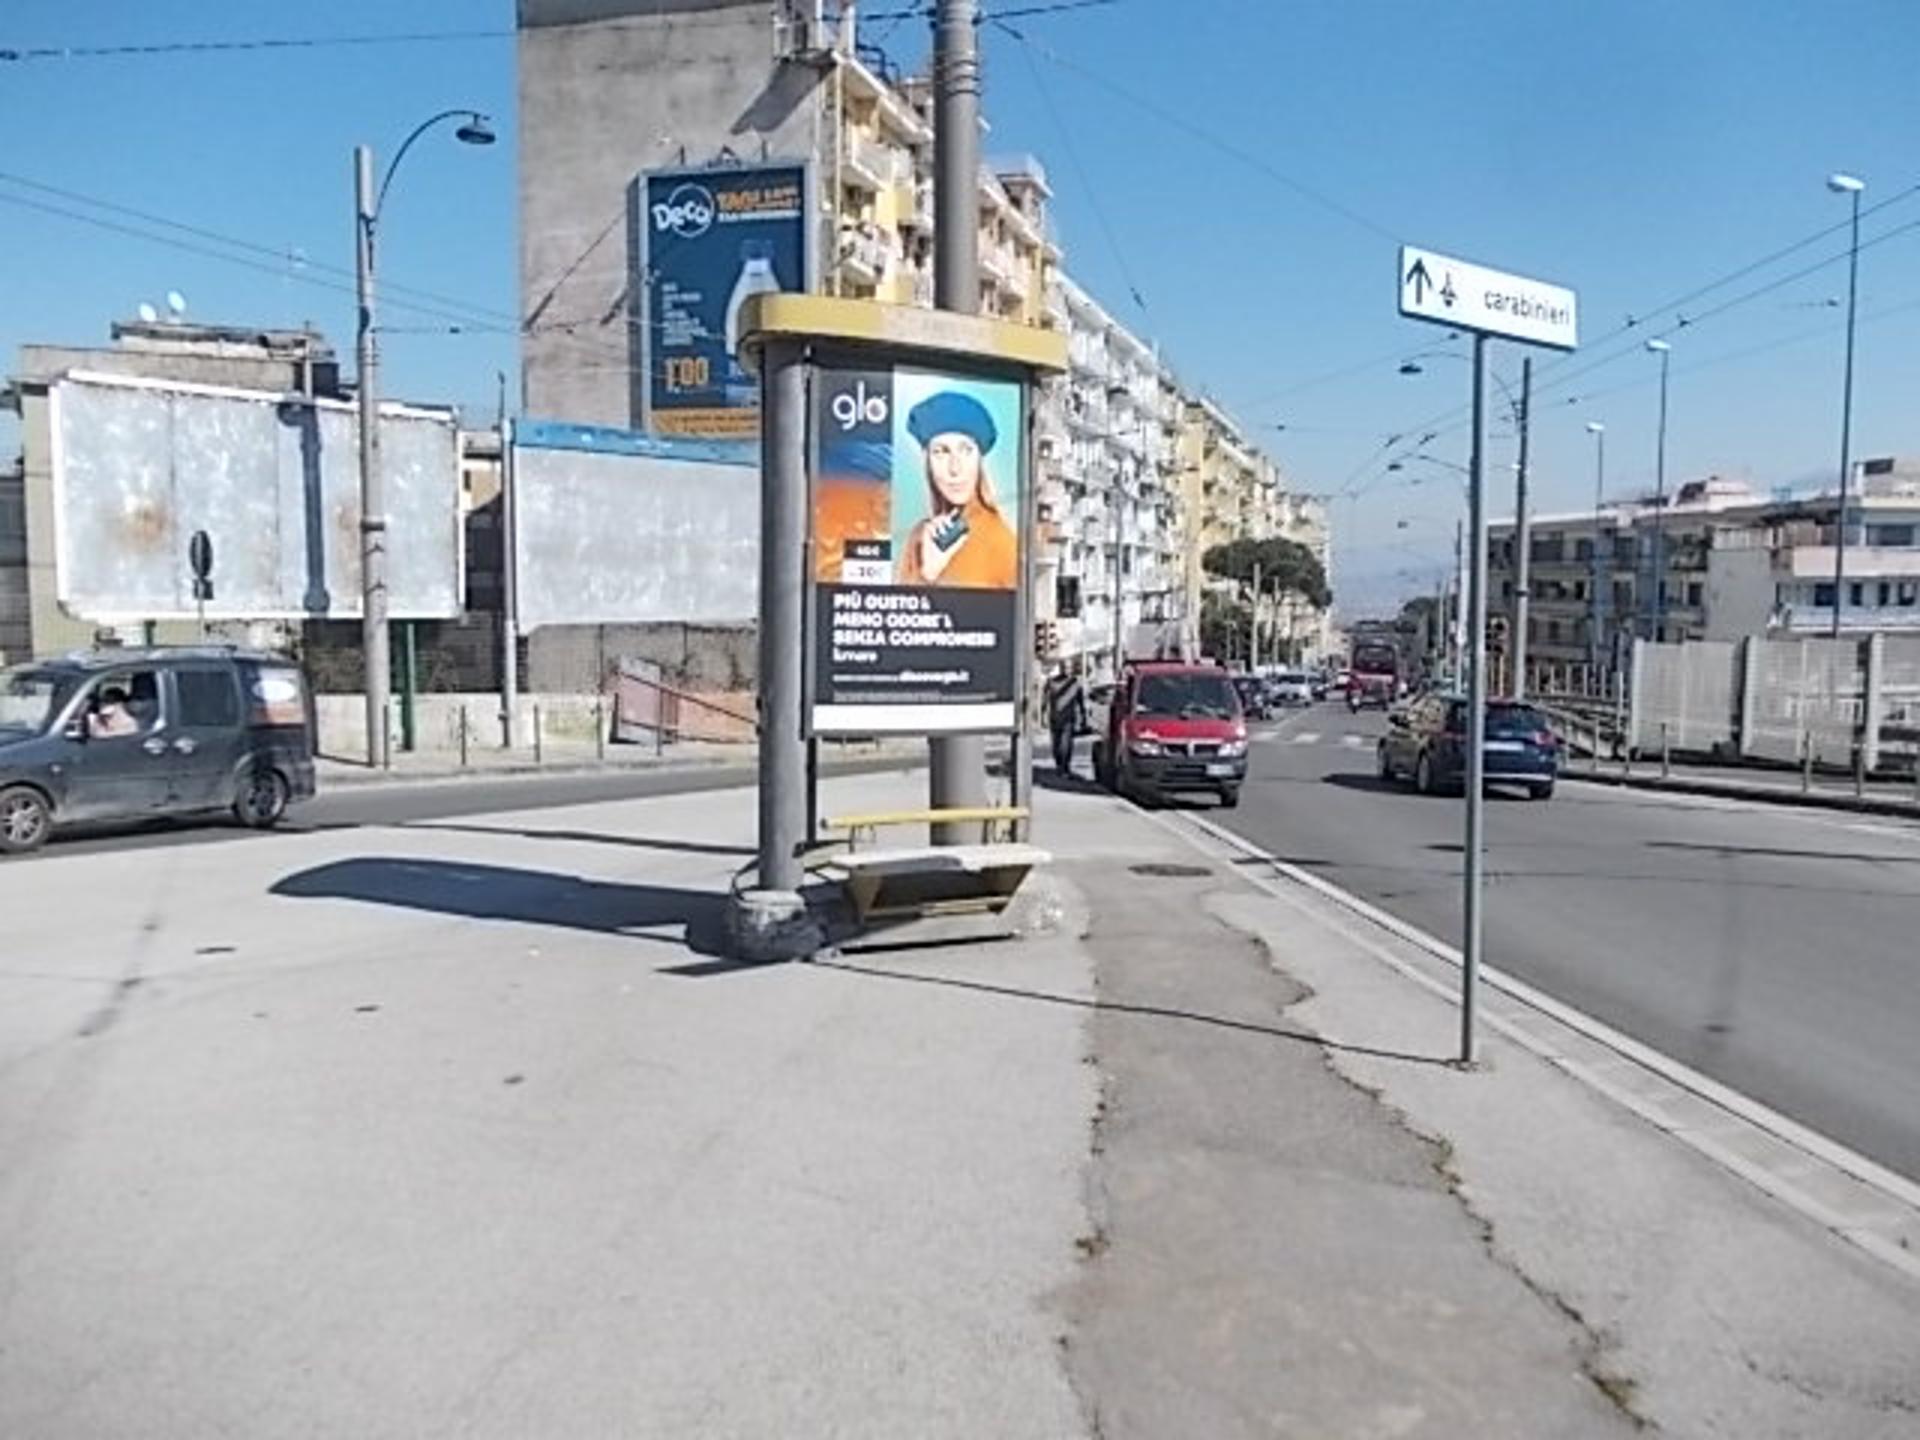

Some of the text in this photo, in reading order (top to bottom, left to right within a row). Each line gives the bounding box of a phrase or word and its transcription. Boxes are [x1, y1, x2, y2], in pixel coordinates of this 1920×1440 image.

[1484, 291, 1571, 325] carabinieri
[864, 594, 919, 610] GUSTO
[833, 611, 883, 627] MENO
[833, 630, 886, 646] SENZA
